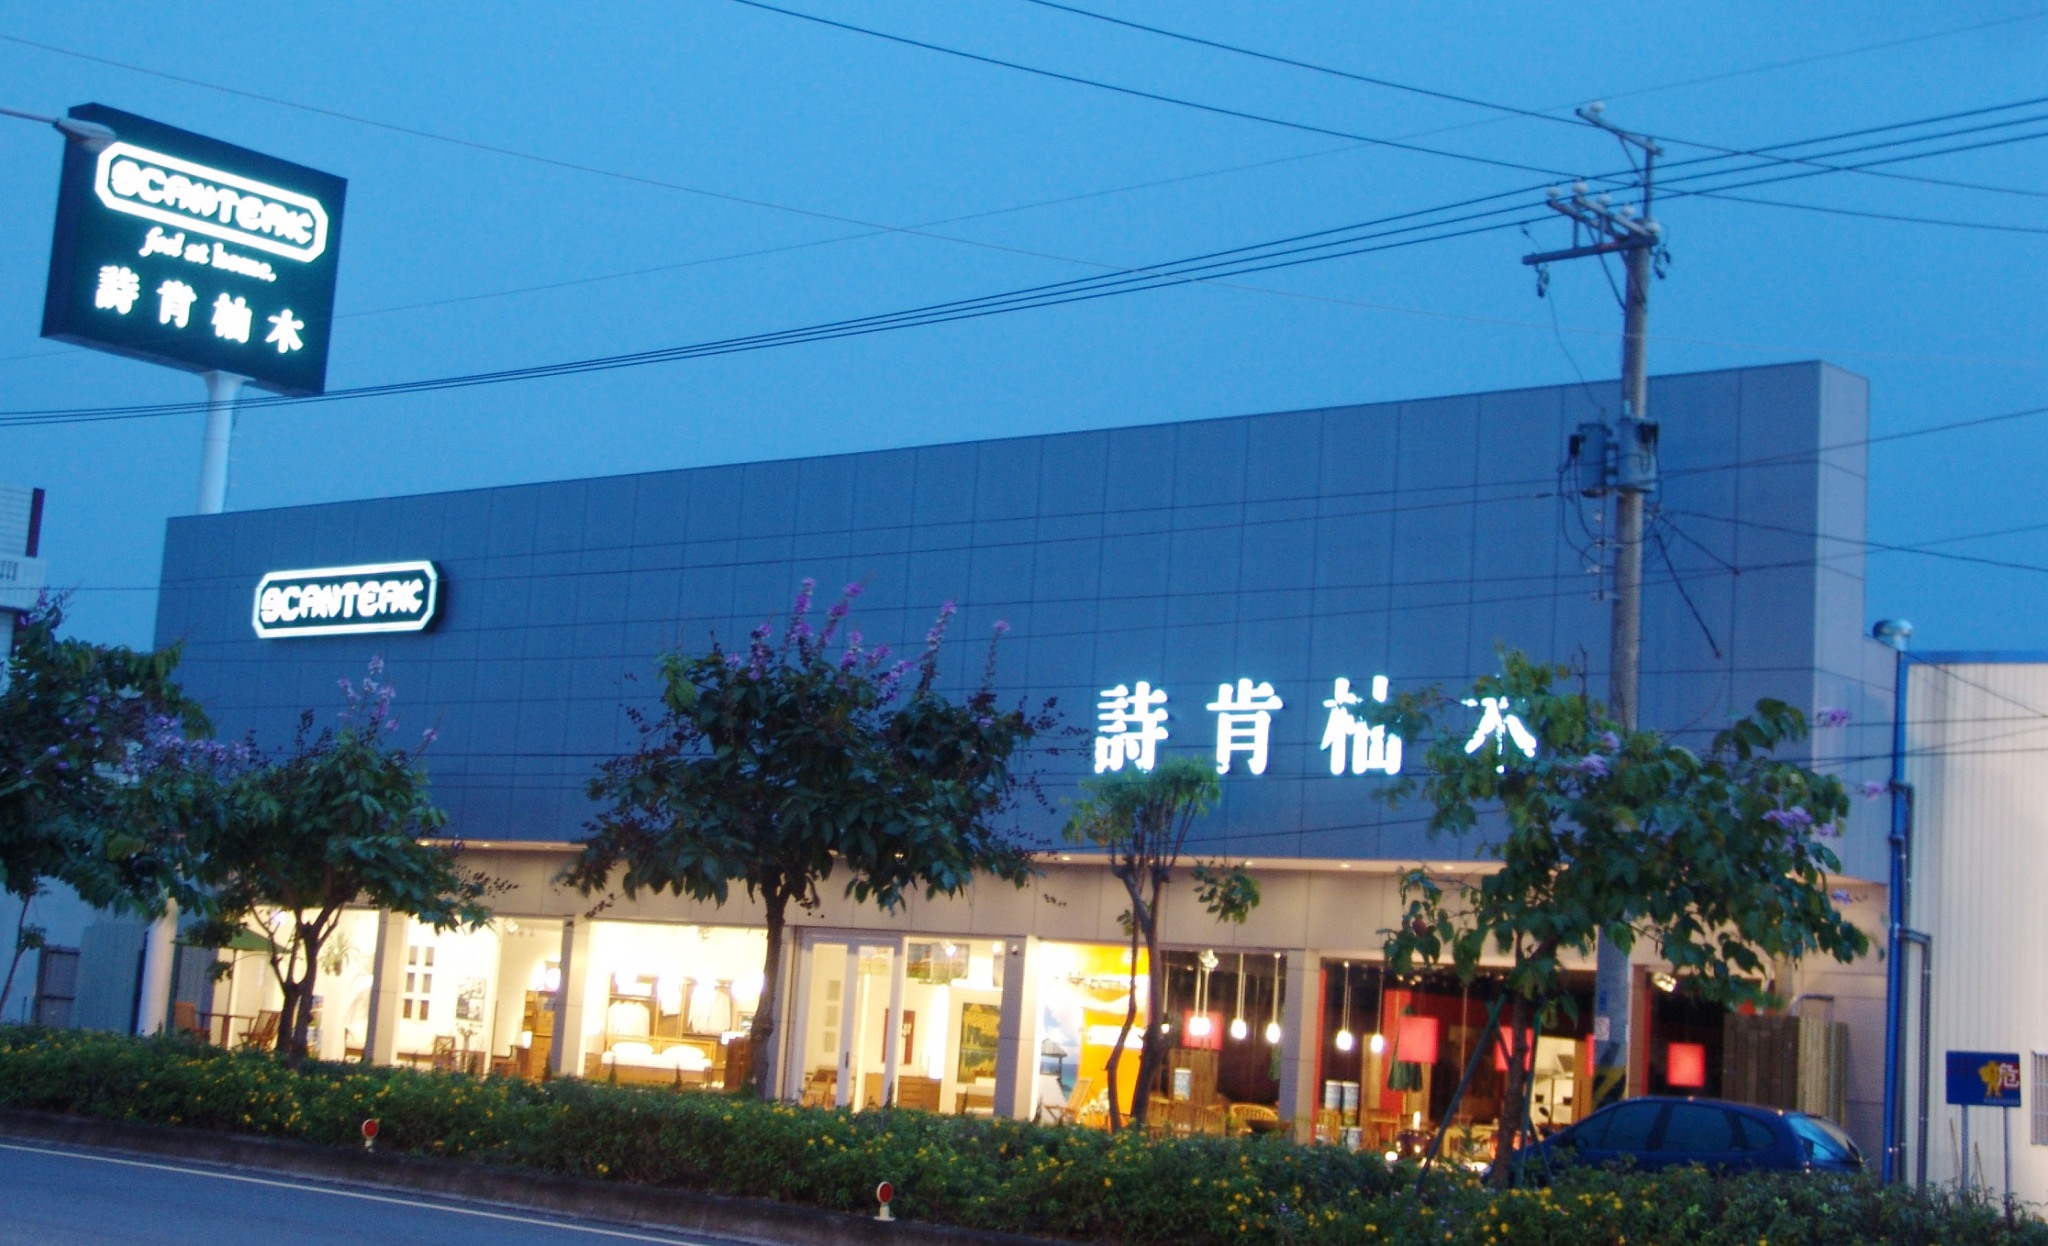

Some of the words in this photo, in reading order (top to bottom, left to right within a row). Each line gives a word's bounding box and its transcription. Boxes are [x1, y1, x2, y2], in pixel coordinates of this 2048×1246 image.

[111, 160, 314, 245] SCANTEAK
[184, 243, 210, 264] at
[260, 578, 424, 623] SCANTEAK
